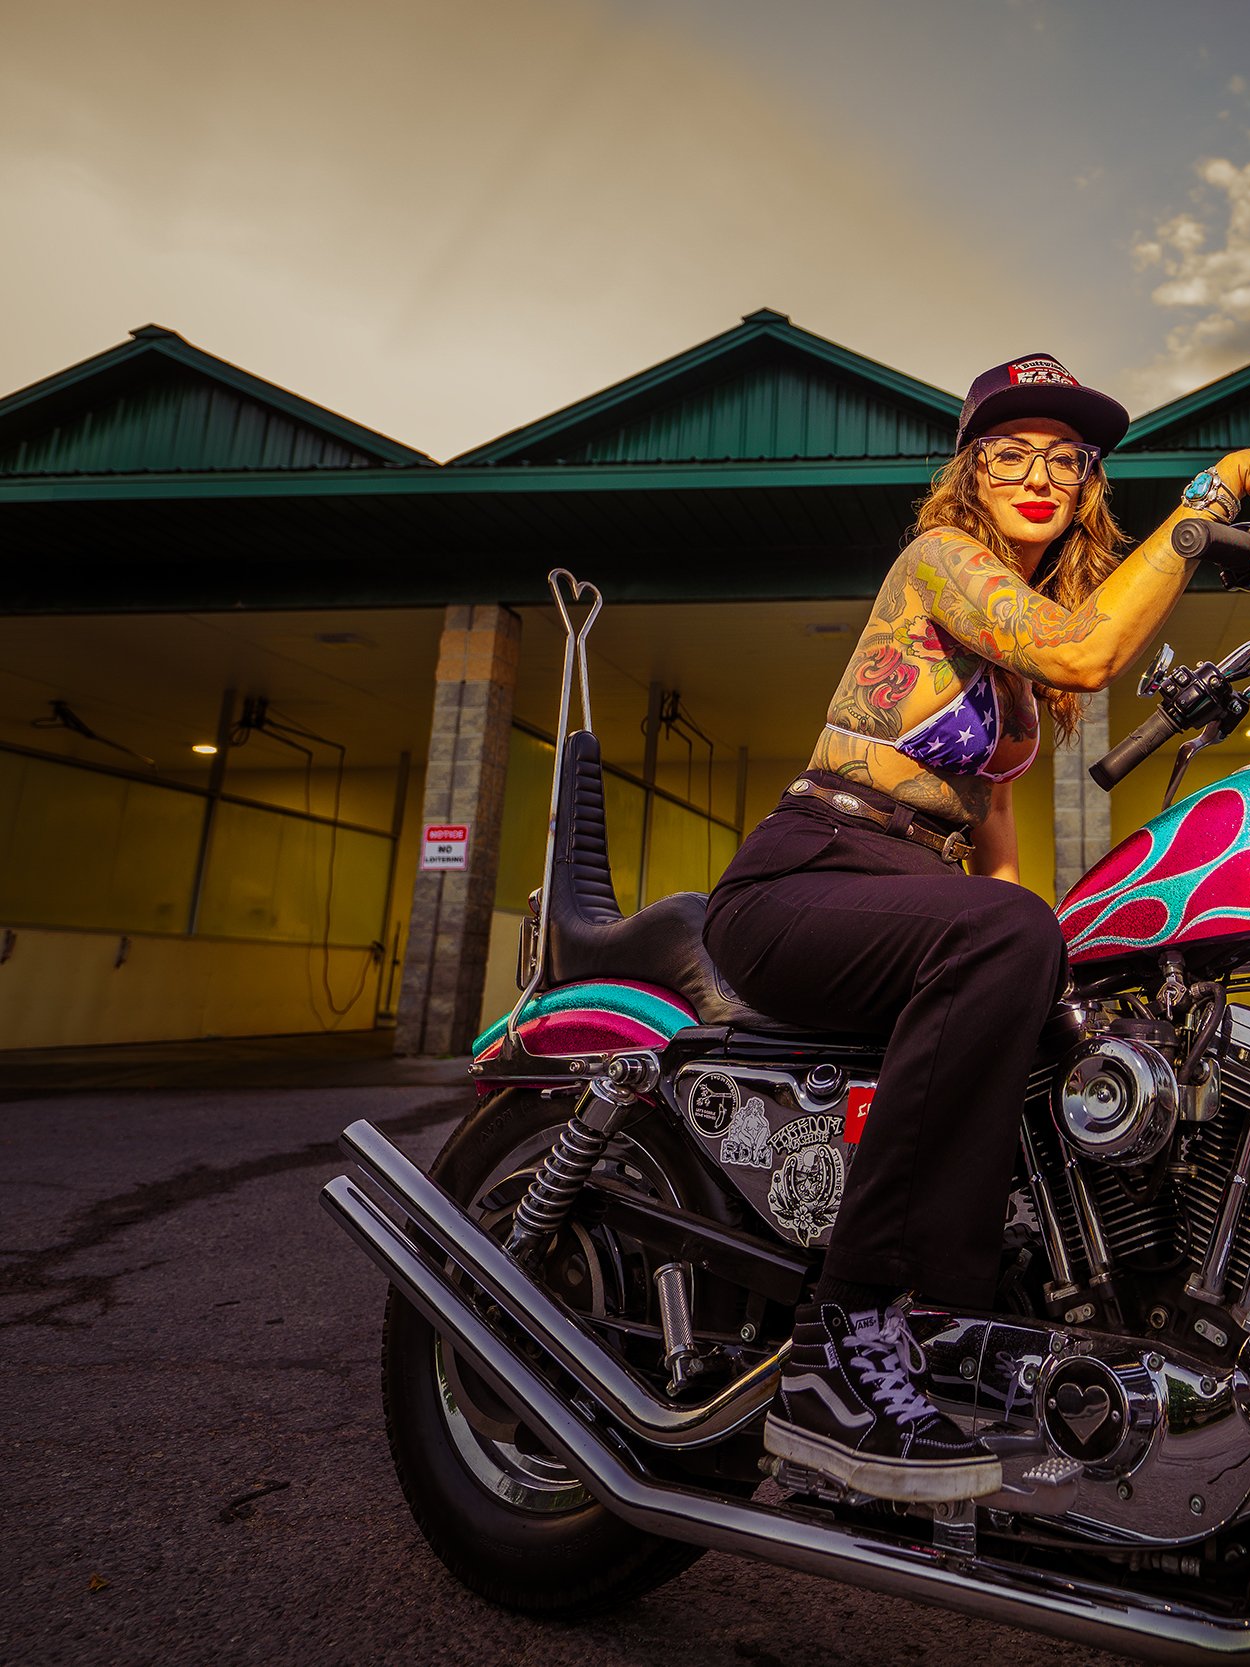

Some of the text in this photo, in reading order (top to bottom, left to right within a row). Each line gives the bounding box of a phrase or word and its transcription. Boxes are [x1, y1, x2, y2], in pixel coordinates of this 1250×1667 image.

[429, 829, 464, 840] NOTICE
[438, 844, 453, 854] NO
[425, 856, 464, 864] LOITERING
[766, 1115, 843, 1153] FREEDOM
[833, 1150, 842, 1191] BILTWELL
[854, 1316, 876, 1330] VANS
